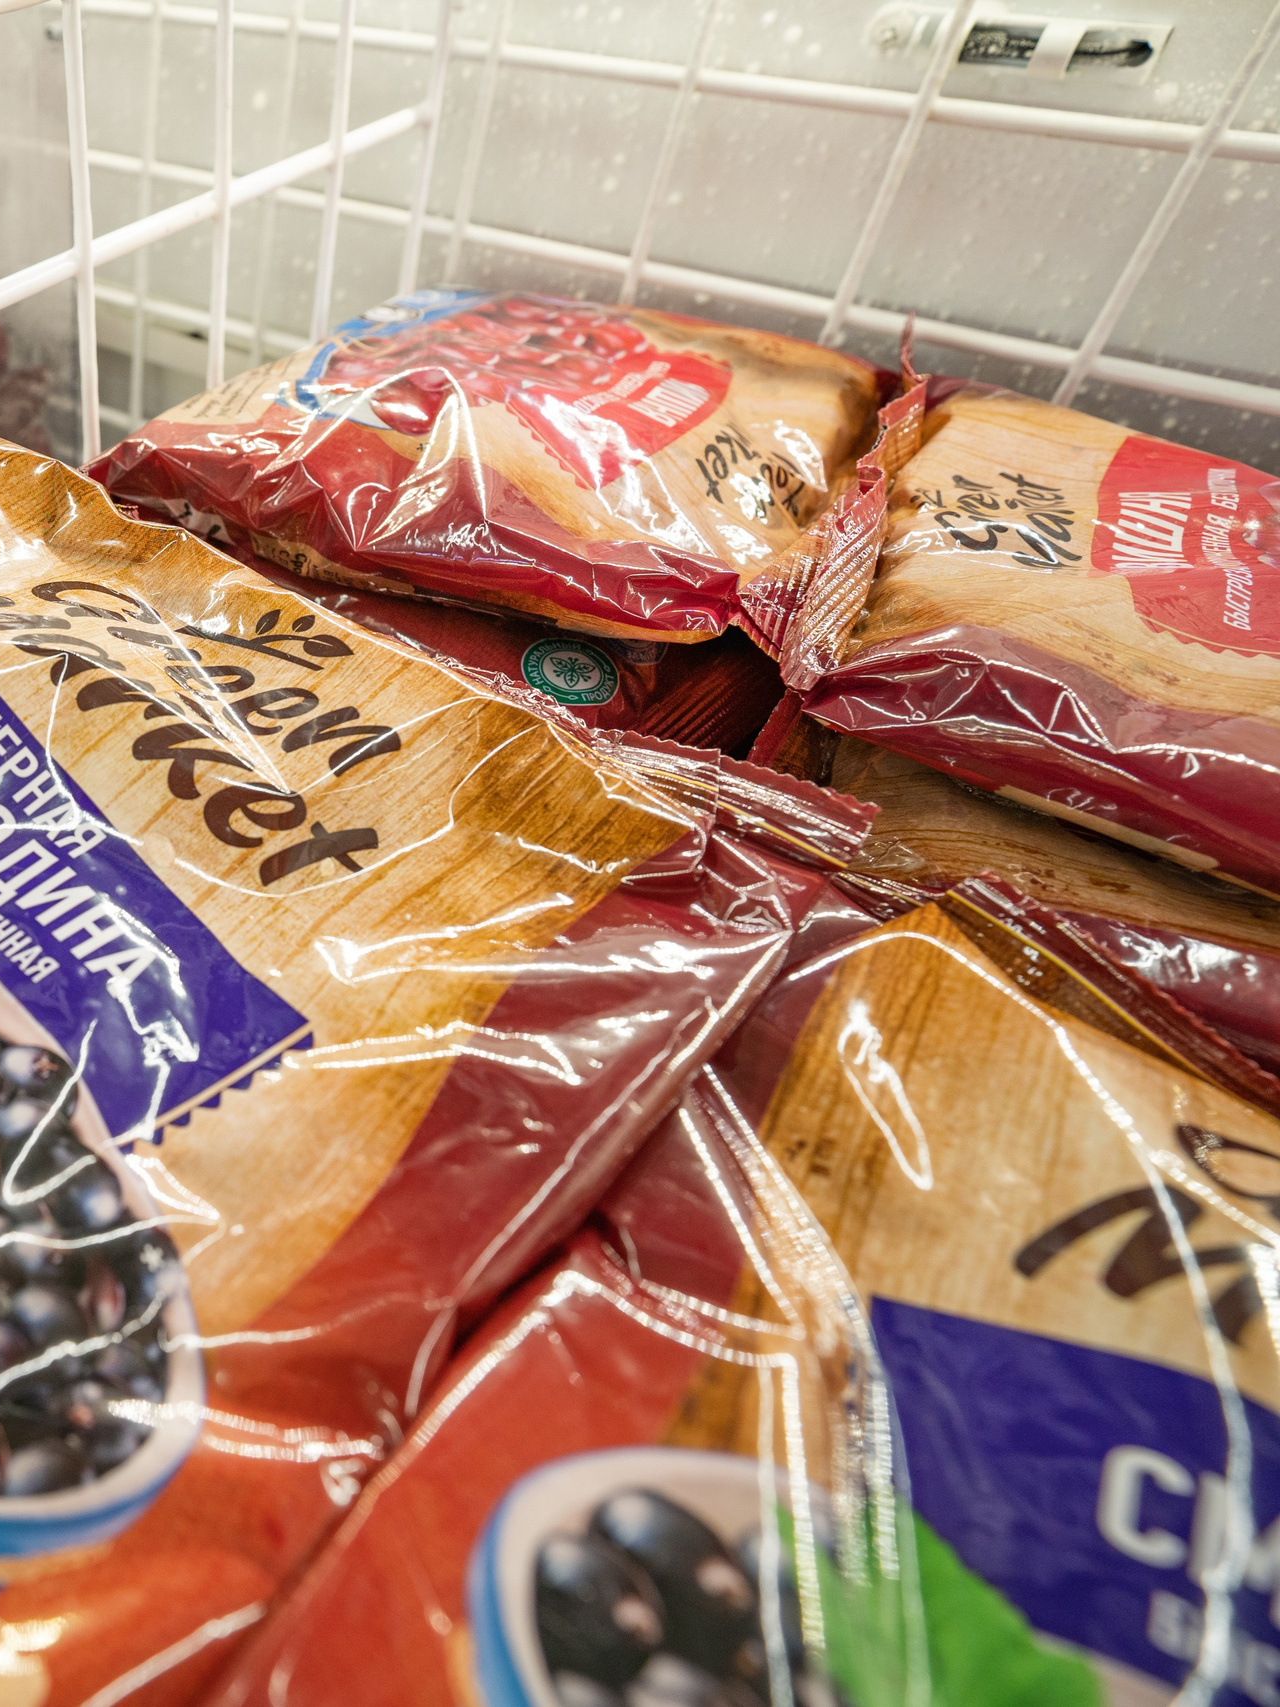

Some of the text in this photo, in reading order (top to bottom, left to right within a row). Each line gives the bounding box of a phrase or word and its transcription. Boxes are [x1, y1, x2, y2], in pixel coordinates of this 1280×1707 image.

[32, 580, 402, 777] Green
[528, 642, 582, 686] НАТУРАЛЬНЫЙ
[581, 673, 615, 702] ПРОДУКТ
